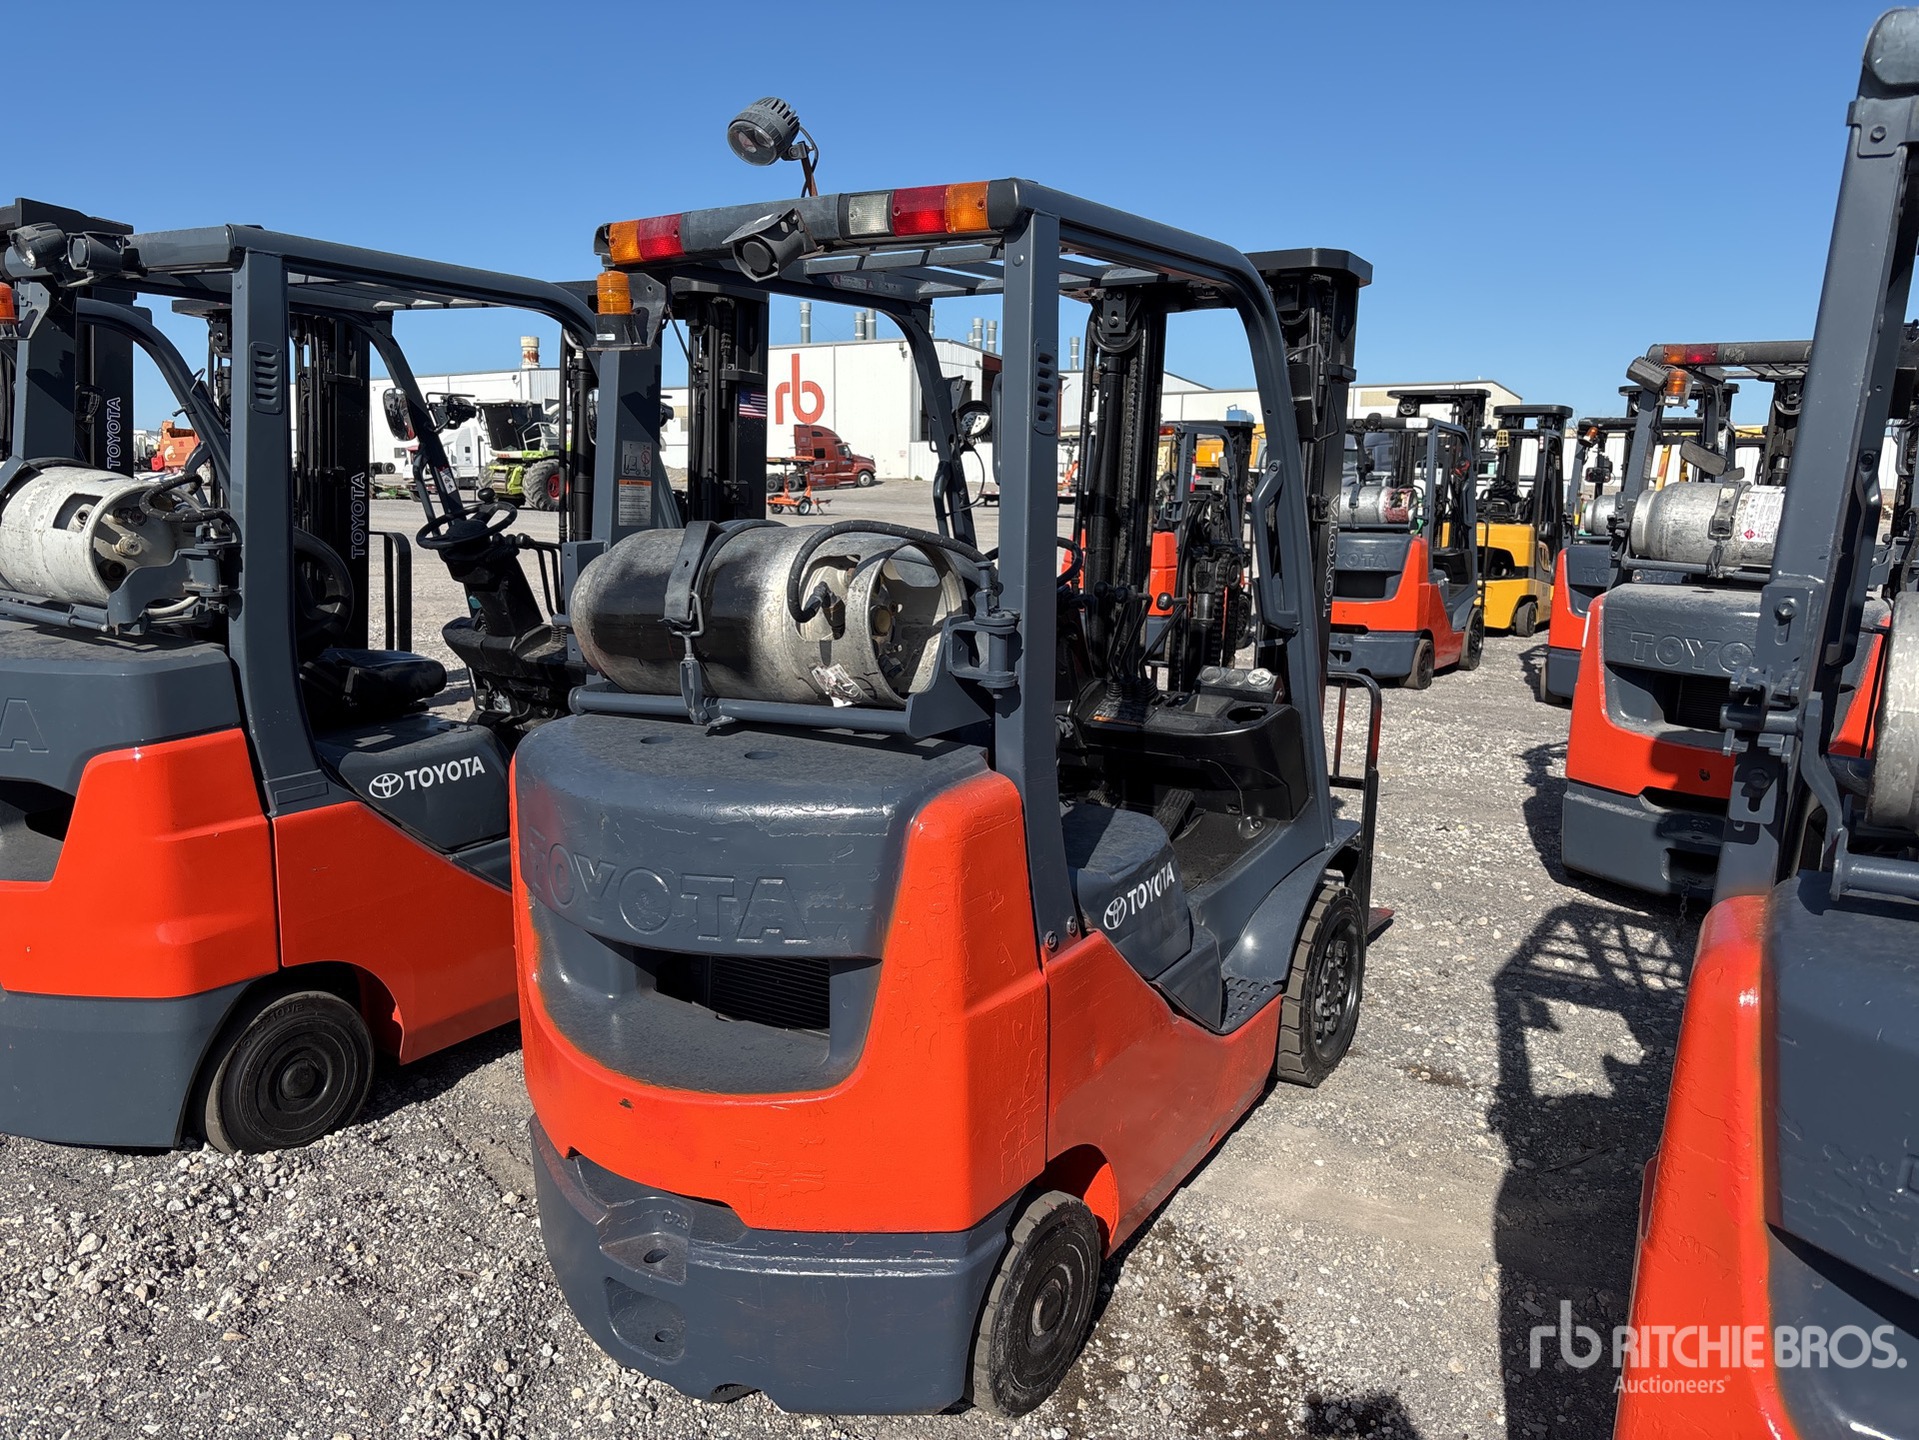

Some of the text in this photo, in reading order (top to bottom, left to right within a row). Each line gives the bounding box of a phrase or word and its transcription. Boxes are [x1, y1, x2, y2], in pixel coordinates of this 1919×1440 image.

[775, 353, 825, 425] rb
[106, 397, 121, 469] TOYOTA
[351, 472, 366, 560] TOYOTA
[1322, 494, 1340, 618] TOYOTA
[404, 755, 486, 791] TOYOTA
[521, 826, 812, 944] TOYOTA
[1127, 861, 1176, 916] TOYOTA
